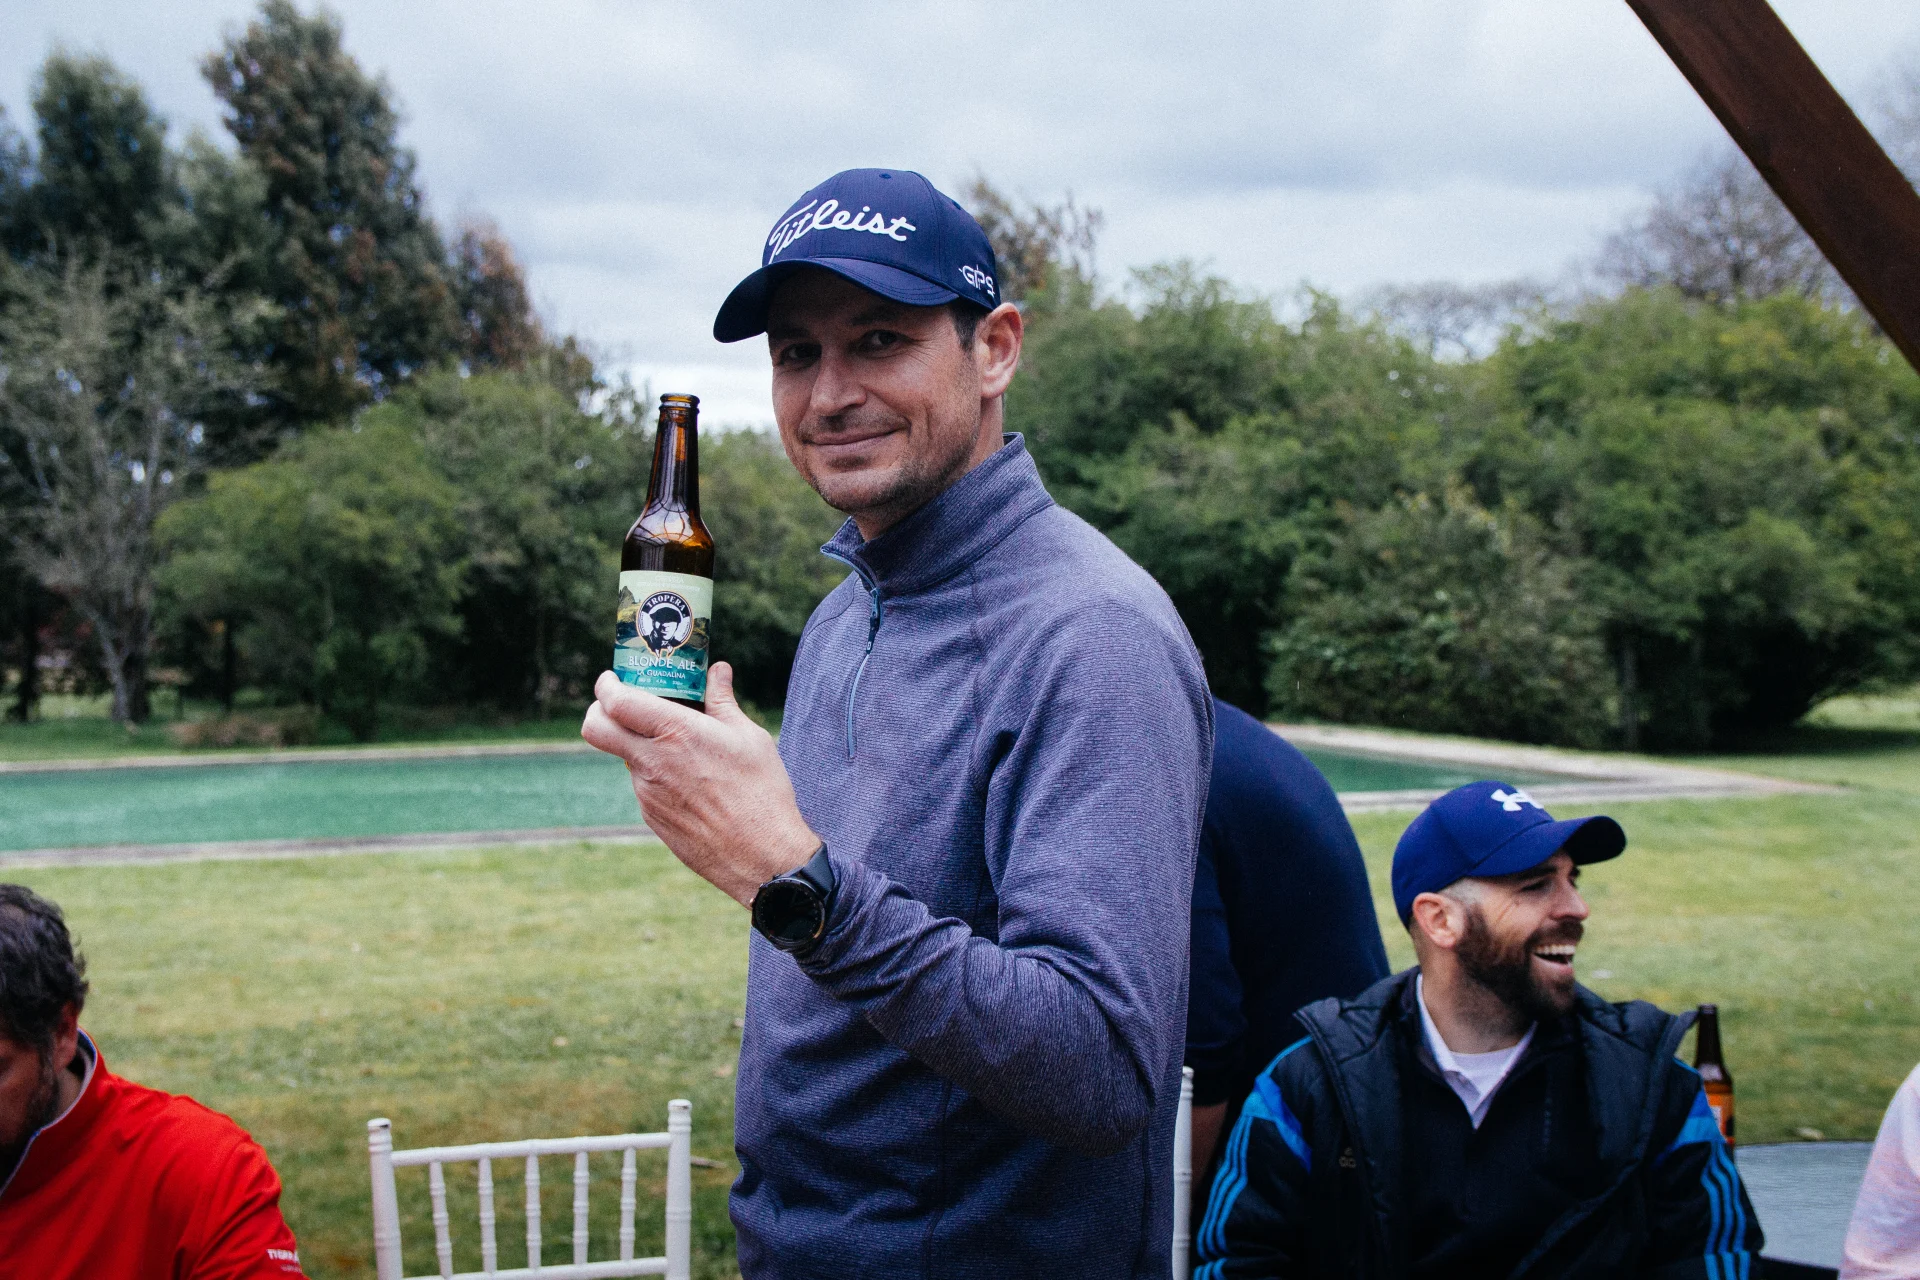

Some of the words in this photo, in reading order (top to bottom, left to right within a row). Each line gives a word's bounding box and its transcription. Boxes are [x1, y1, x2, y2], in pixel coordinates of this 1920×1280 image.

[768, 199, 917, 265] Titleist
[646, 594, 686, 611] TROPERA
[628, 655, 673, 669] BLONDE
[677, 660, 696, 672] ALE
[646, 669, 686, 679] GUADALINA
